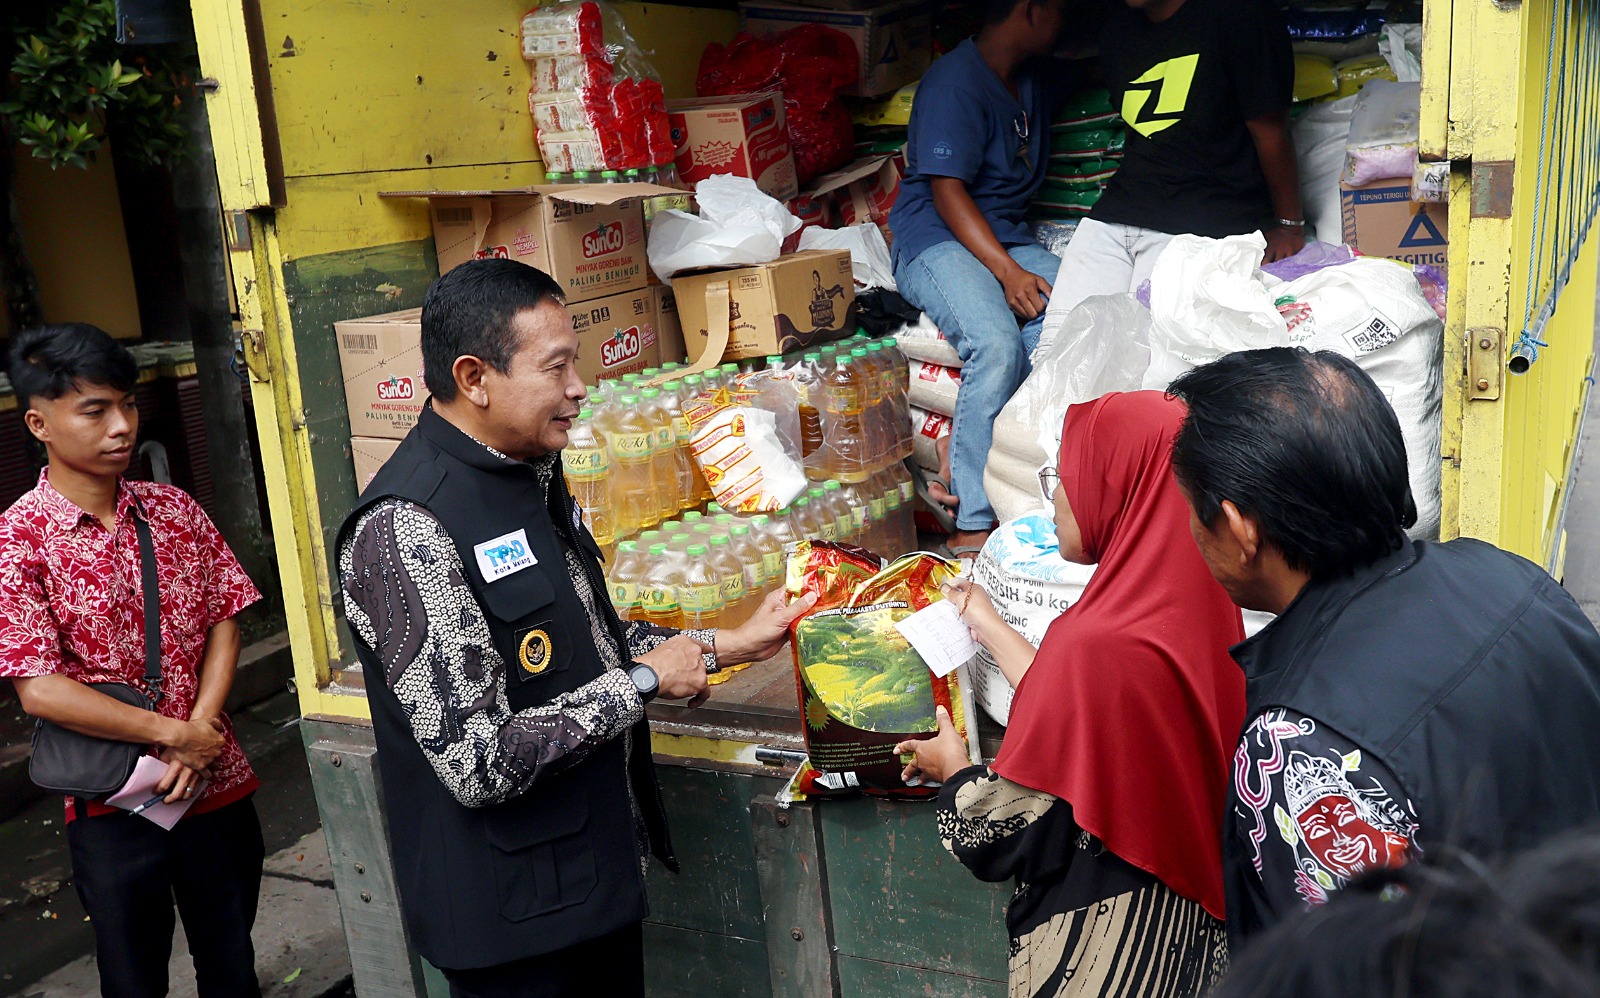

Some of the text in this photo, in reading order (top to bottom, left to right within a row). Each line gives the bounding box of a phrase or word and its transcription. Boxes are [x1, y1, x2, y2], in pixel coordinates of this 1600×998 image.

[1359, 193, 1382, 201] TEPUNG
[1383, 192, 1403, 200] TERIGU
[584, 226, 621, 257] SunCo
[575, 263, 599, 274] MINYAK
[570, 273, 601, 288] PALING
[571, 315, 579, 330] 2
[603, 333, 638, 364] SunCo
[379, 380, 412, 398] SunCo
[371, 403, 423, 412] MINYAK GORENG BAI
[366, 412, 394, 421] PALING
[617, 436, 645, 450] Rizki
[494, 565, 511, 575] Kota
[988, 570, 1020, 602] BERSIH
[1024, 590, 1044, 607] 50
[1048, 592, 1070, 614] kg
